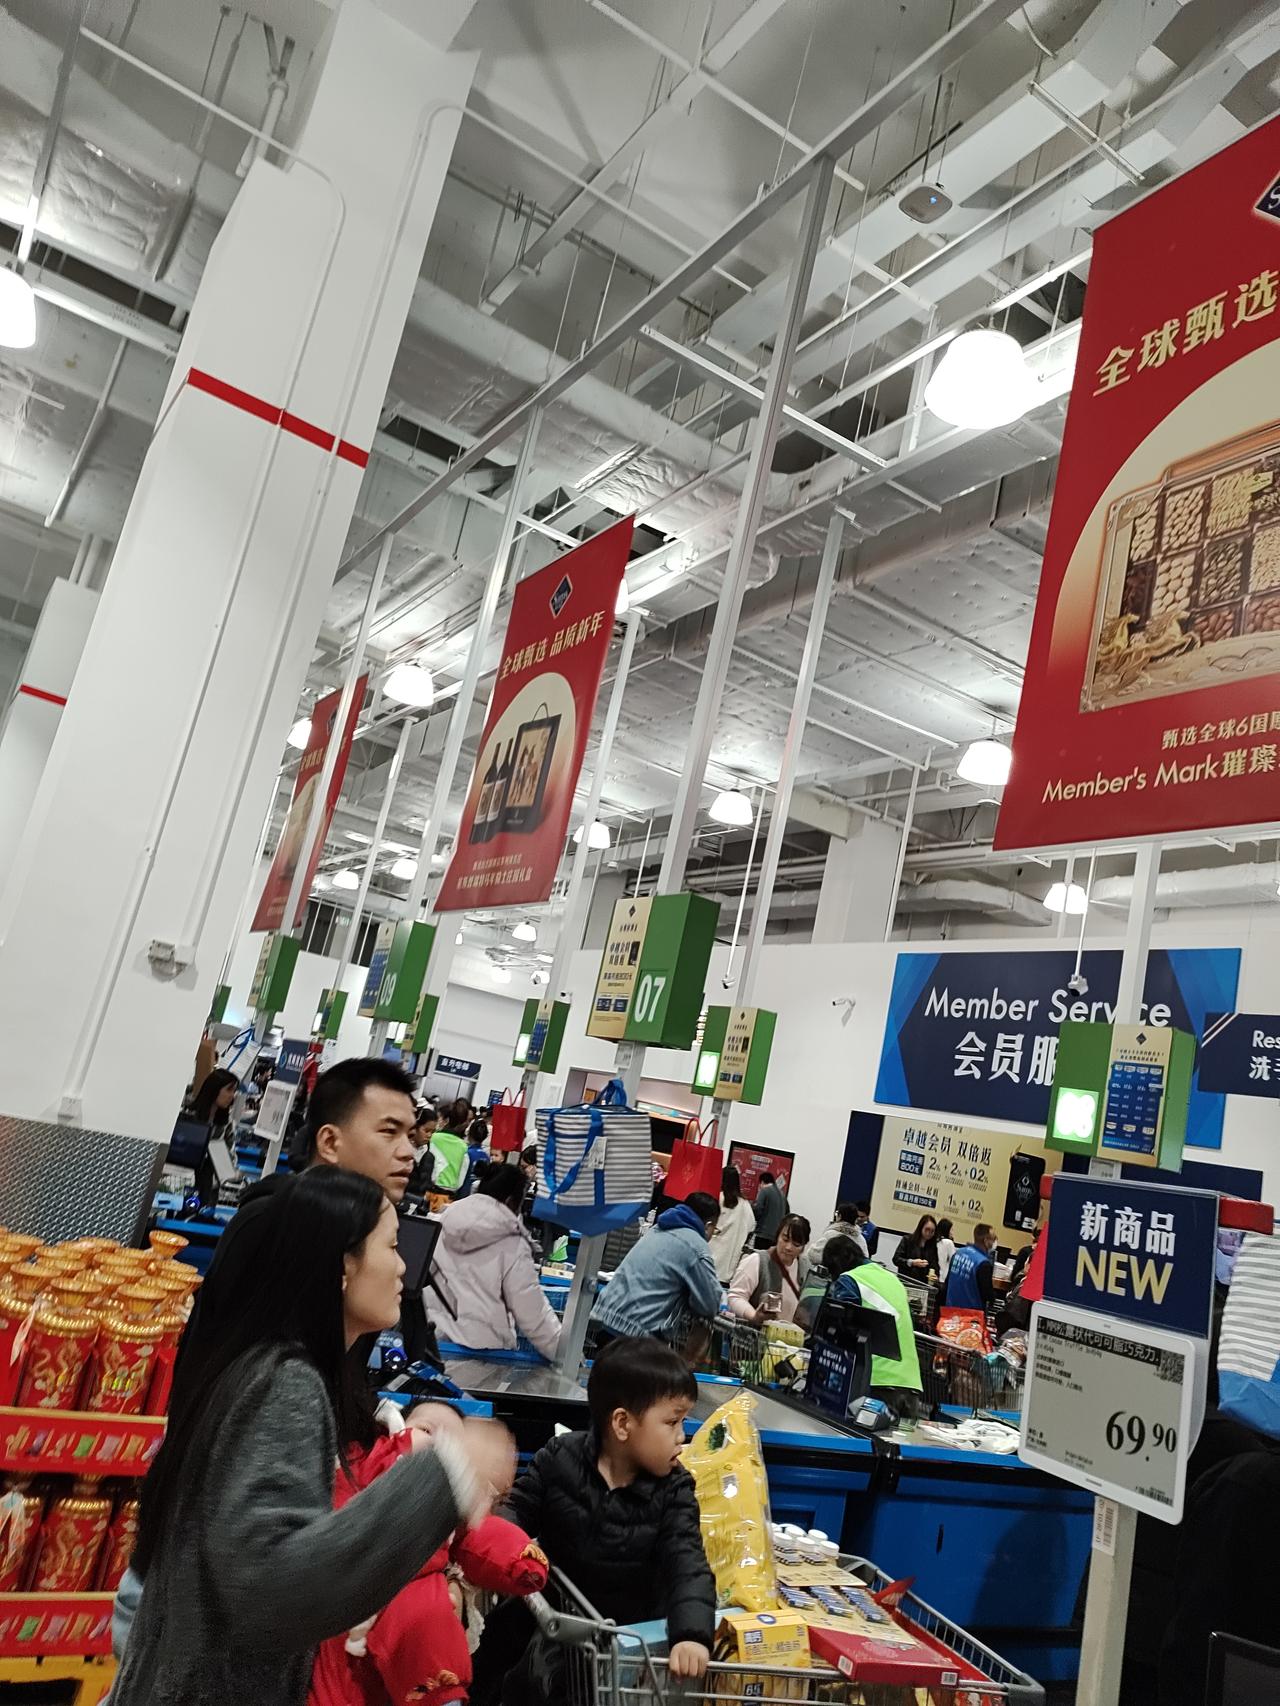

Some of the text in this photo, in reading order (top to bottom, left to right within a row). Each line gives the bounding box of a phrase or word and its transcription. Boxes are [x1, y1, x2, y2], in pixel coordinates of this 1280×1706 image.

[1093, 269, 1280, 397] 全球甄选
[1042, 767, 1147, 804] Member's
[634, 973, 667, 1023] 07
[924, 986, 1172, 1027] Member Serve
[903, 1127, 992, 1166] 卓越会员 双倍返
[1080, 1201, 1176, 1257] 新商品
[1075, 1245, 1174, 1305] NEW
